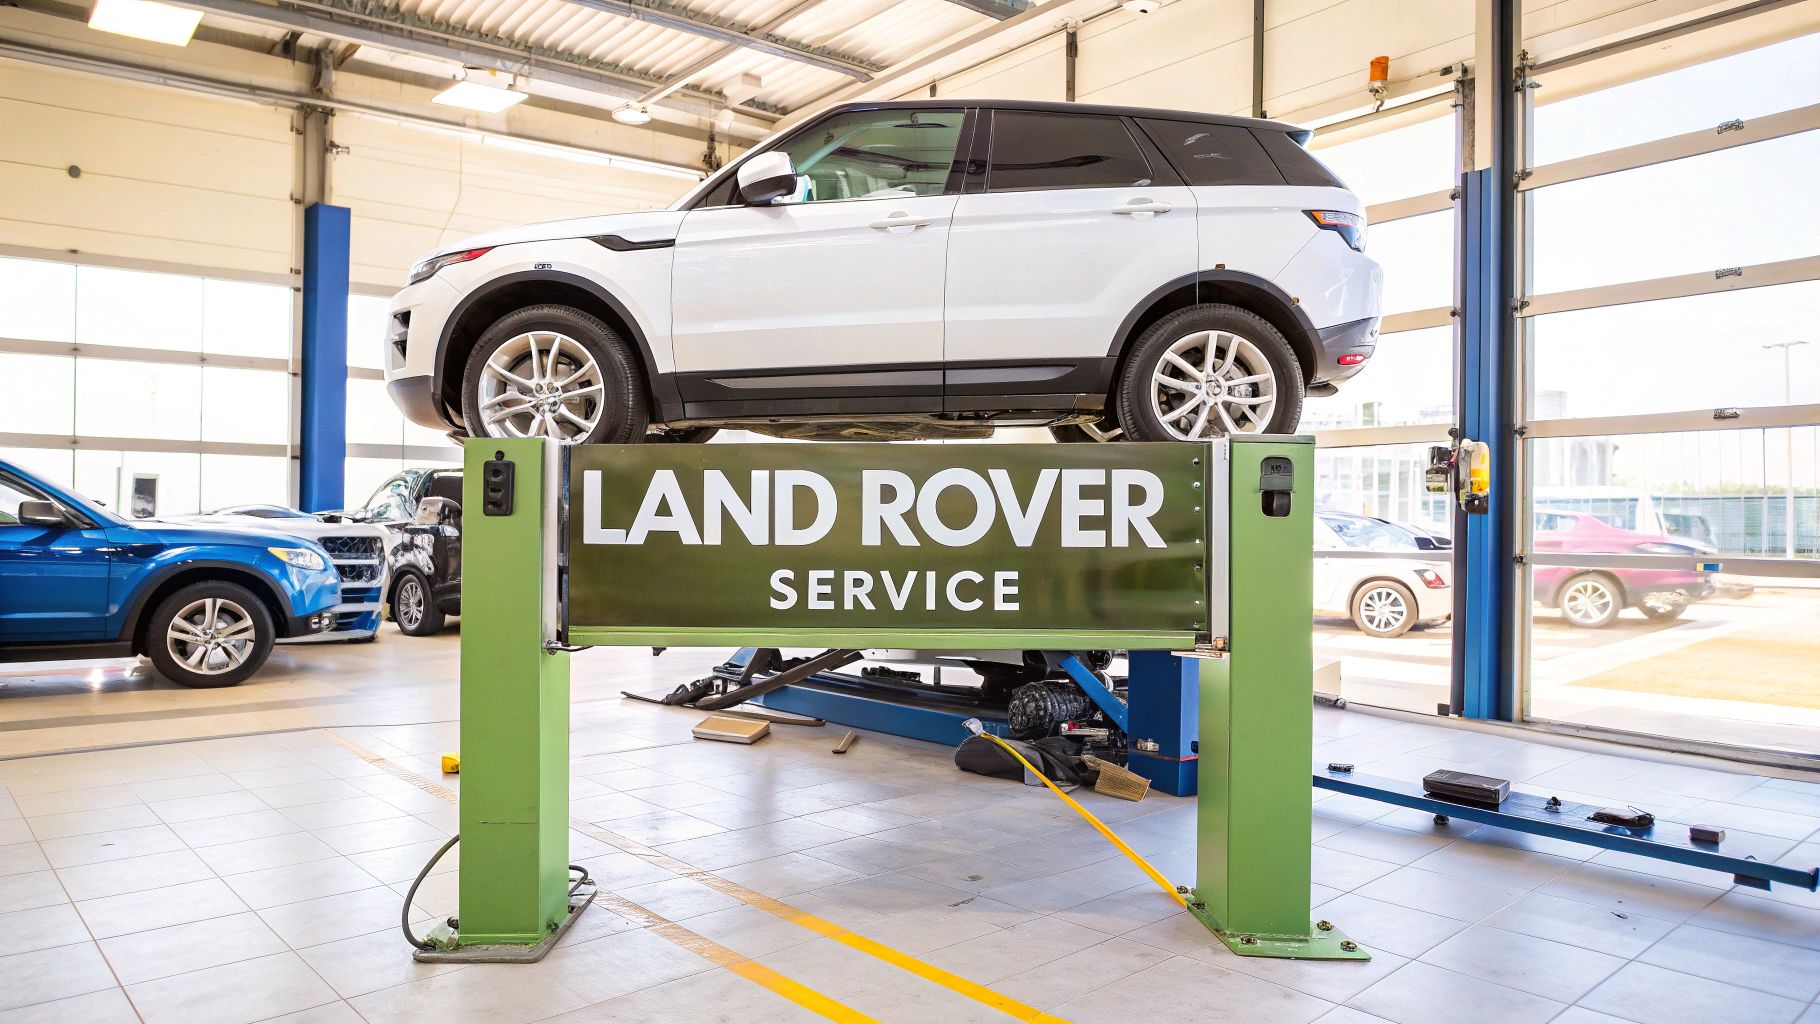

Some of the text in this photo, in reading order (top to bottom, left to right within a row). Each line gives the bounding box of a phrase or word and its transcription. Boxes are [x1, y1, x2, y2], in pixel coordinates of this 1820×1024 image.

[583, 468, 1167, 548] LAND ROVER
[769, 568, 1020, 611] SERVICE
